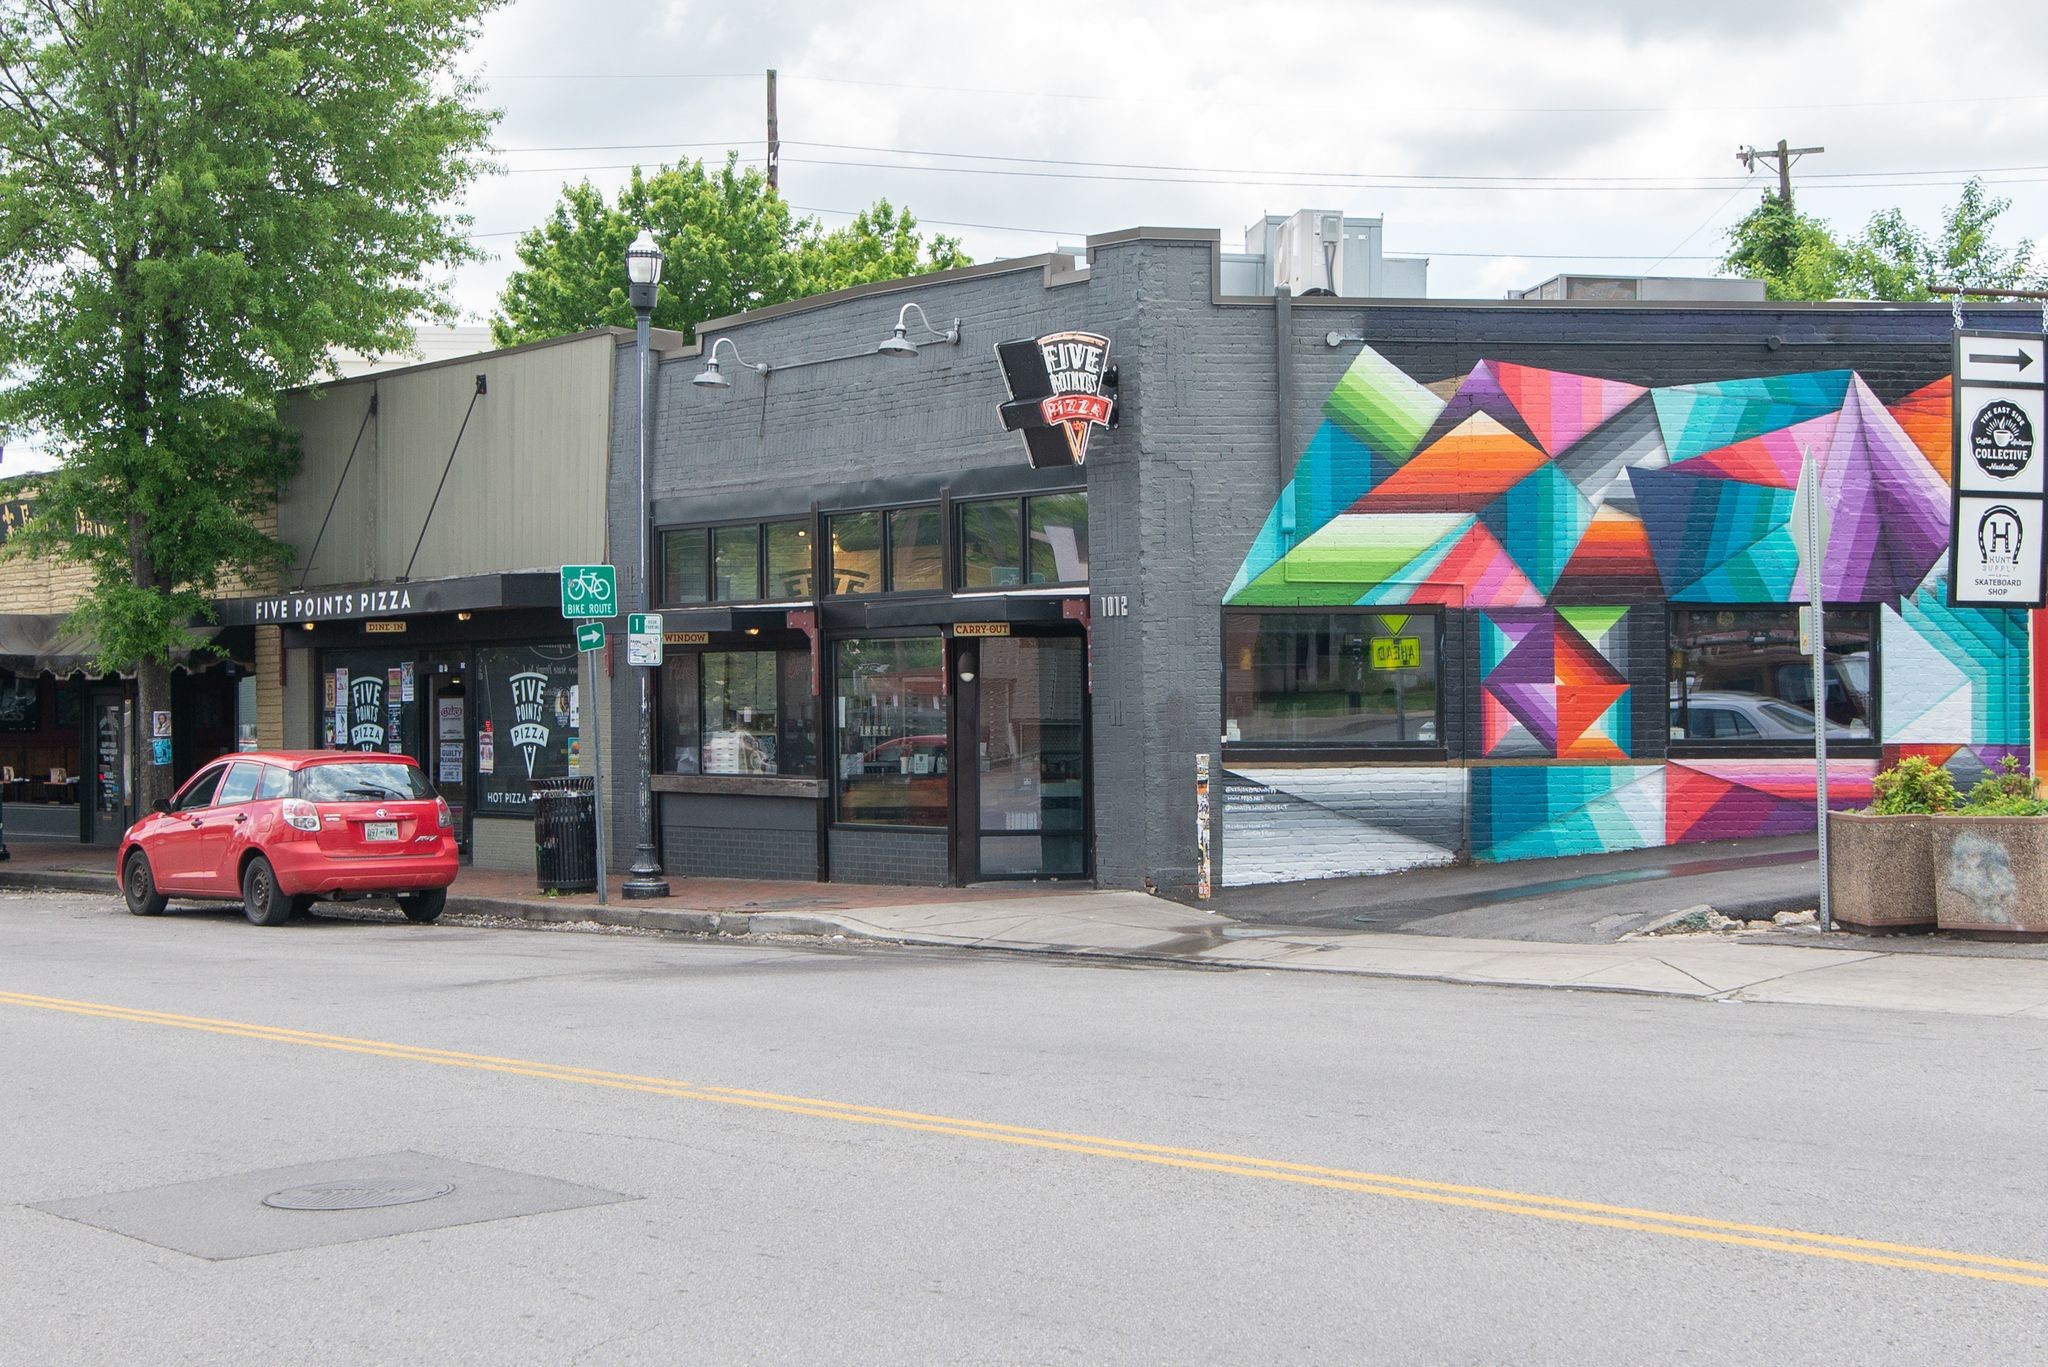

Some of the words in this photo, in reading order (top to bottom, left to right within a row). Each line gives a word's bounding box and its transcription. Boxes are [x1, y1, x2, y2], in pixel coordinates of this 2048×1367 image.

[1042, 343, 1103, 374] FIVE
[1047, 399, 1102, 418] PIZZA
[1980, 410, 1993, 424] THE
[1993, 406, 2011, 415] EAST
[2011, 410, 2026, 427] SIDE
[1975, 448, 2028, 460] COLLECTIVE
[1989, 556, 2012, 564] HUNT
[1982, 565, 2017, 573] SUPPLY
[1974, 578, 2022, 587] SKATEBOARD
[1988, 588, 2008, 596] SHOP
[255, 600, 288, 620] FIVE
[295, 594, 353, 617] POINTS
[360, 589, 411, 612] PIZZA
[567, 603, 585, 614] BIKE
[589, 603, 612, 614] ROUTE
[1101, 595, 1128, 616] 1012
[368, 623, 405, 632] DINE-IN
[955, 624, 1009, 634] CARRY-OUT
[664, 634, 706, 642] WINDOW
[353, 682, 382, 707] FIVE
[511, 679, 546, 705] FIVE
[356, 705, 379, 723] POINTS
[515, 703, 542, 722] POINTS
[354, 726, 381, 740] PIZZA
[514, 726, 545, 742] PIZZA
[487, 792, 503, 804] HOT
[505, 792, 527, 804] PIZZA
